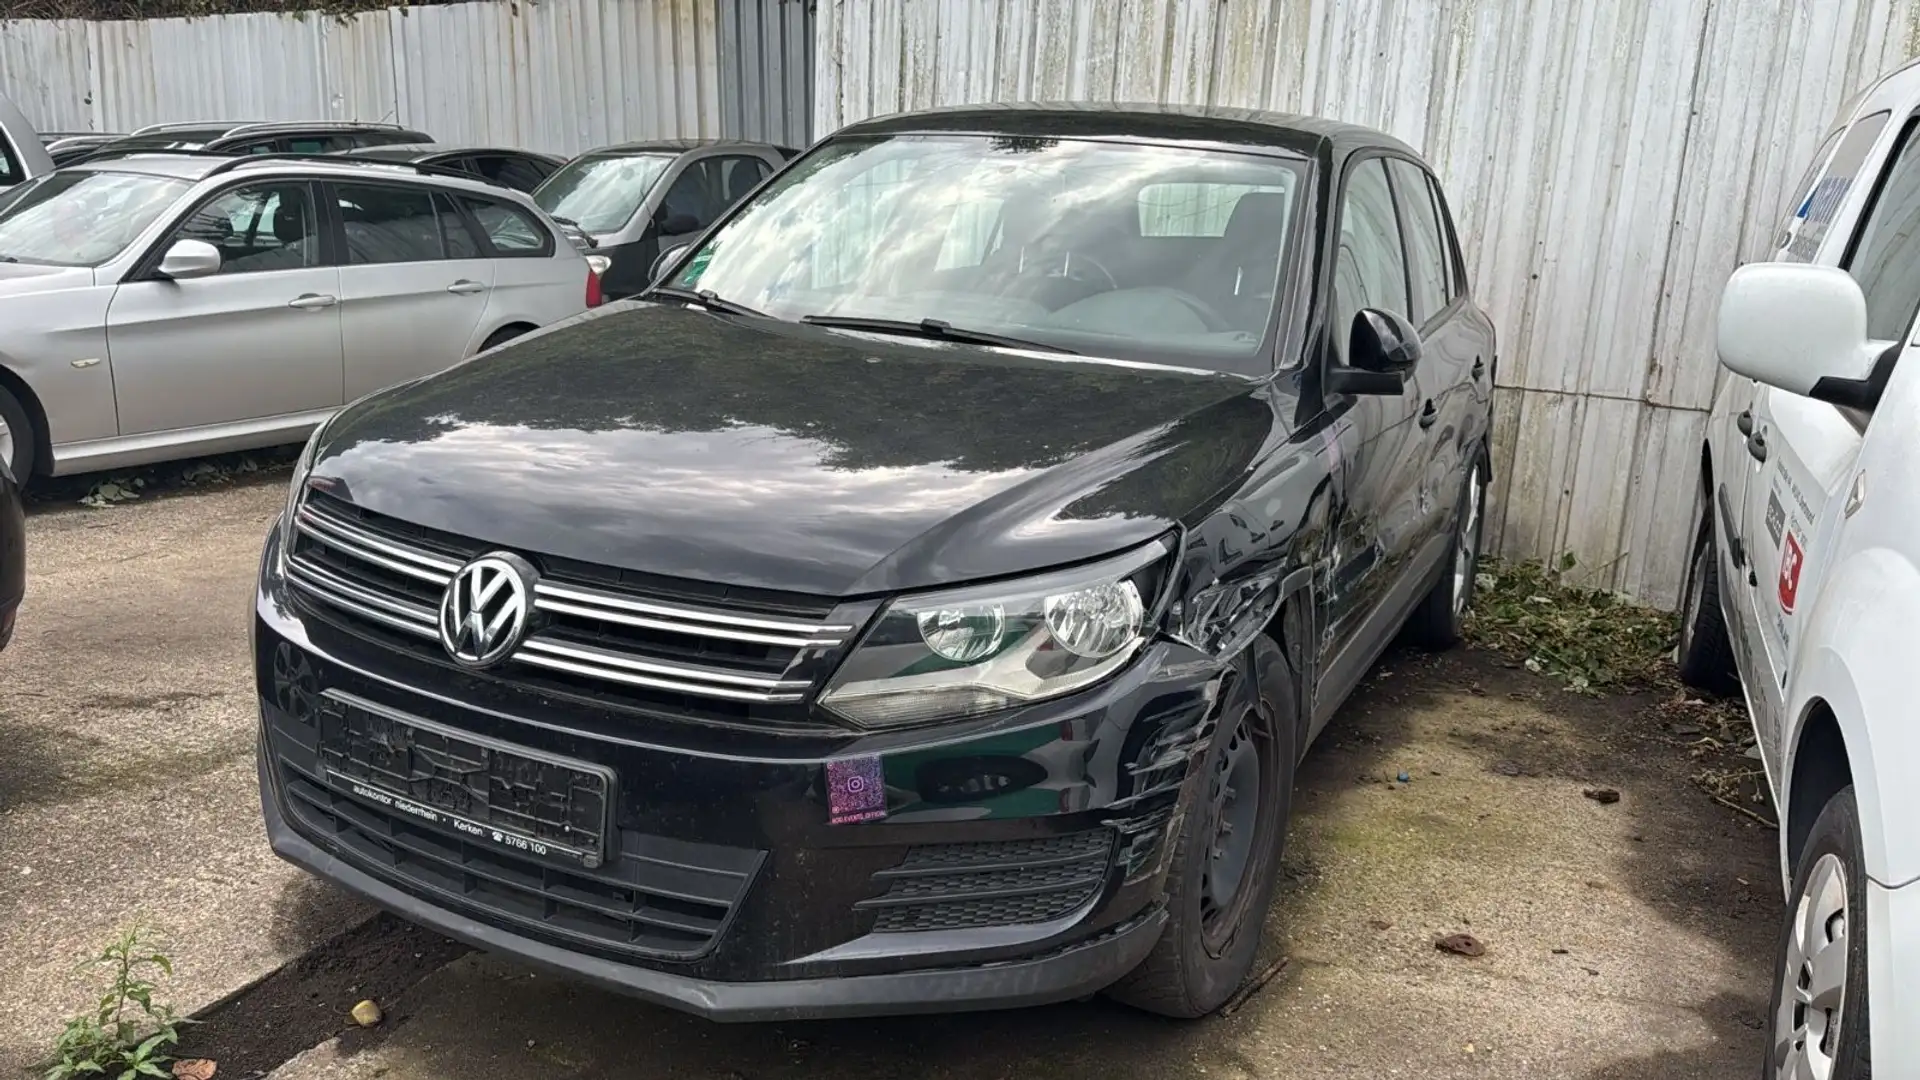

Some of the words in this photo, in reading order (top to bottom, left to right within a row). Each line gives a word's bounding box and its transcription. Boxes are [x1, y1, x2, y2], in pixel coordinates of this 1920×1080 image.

[353, 785, 392, 804] autokontor
[395, 800, 437, 821] niederrhein
[454, 819, 483, 836] Kerken
[505, 836, 527, 850] 5766
[529, 843, 546, 855] 100
